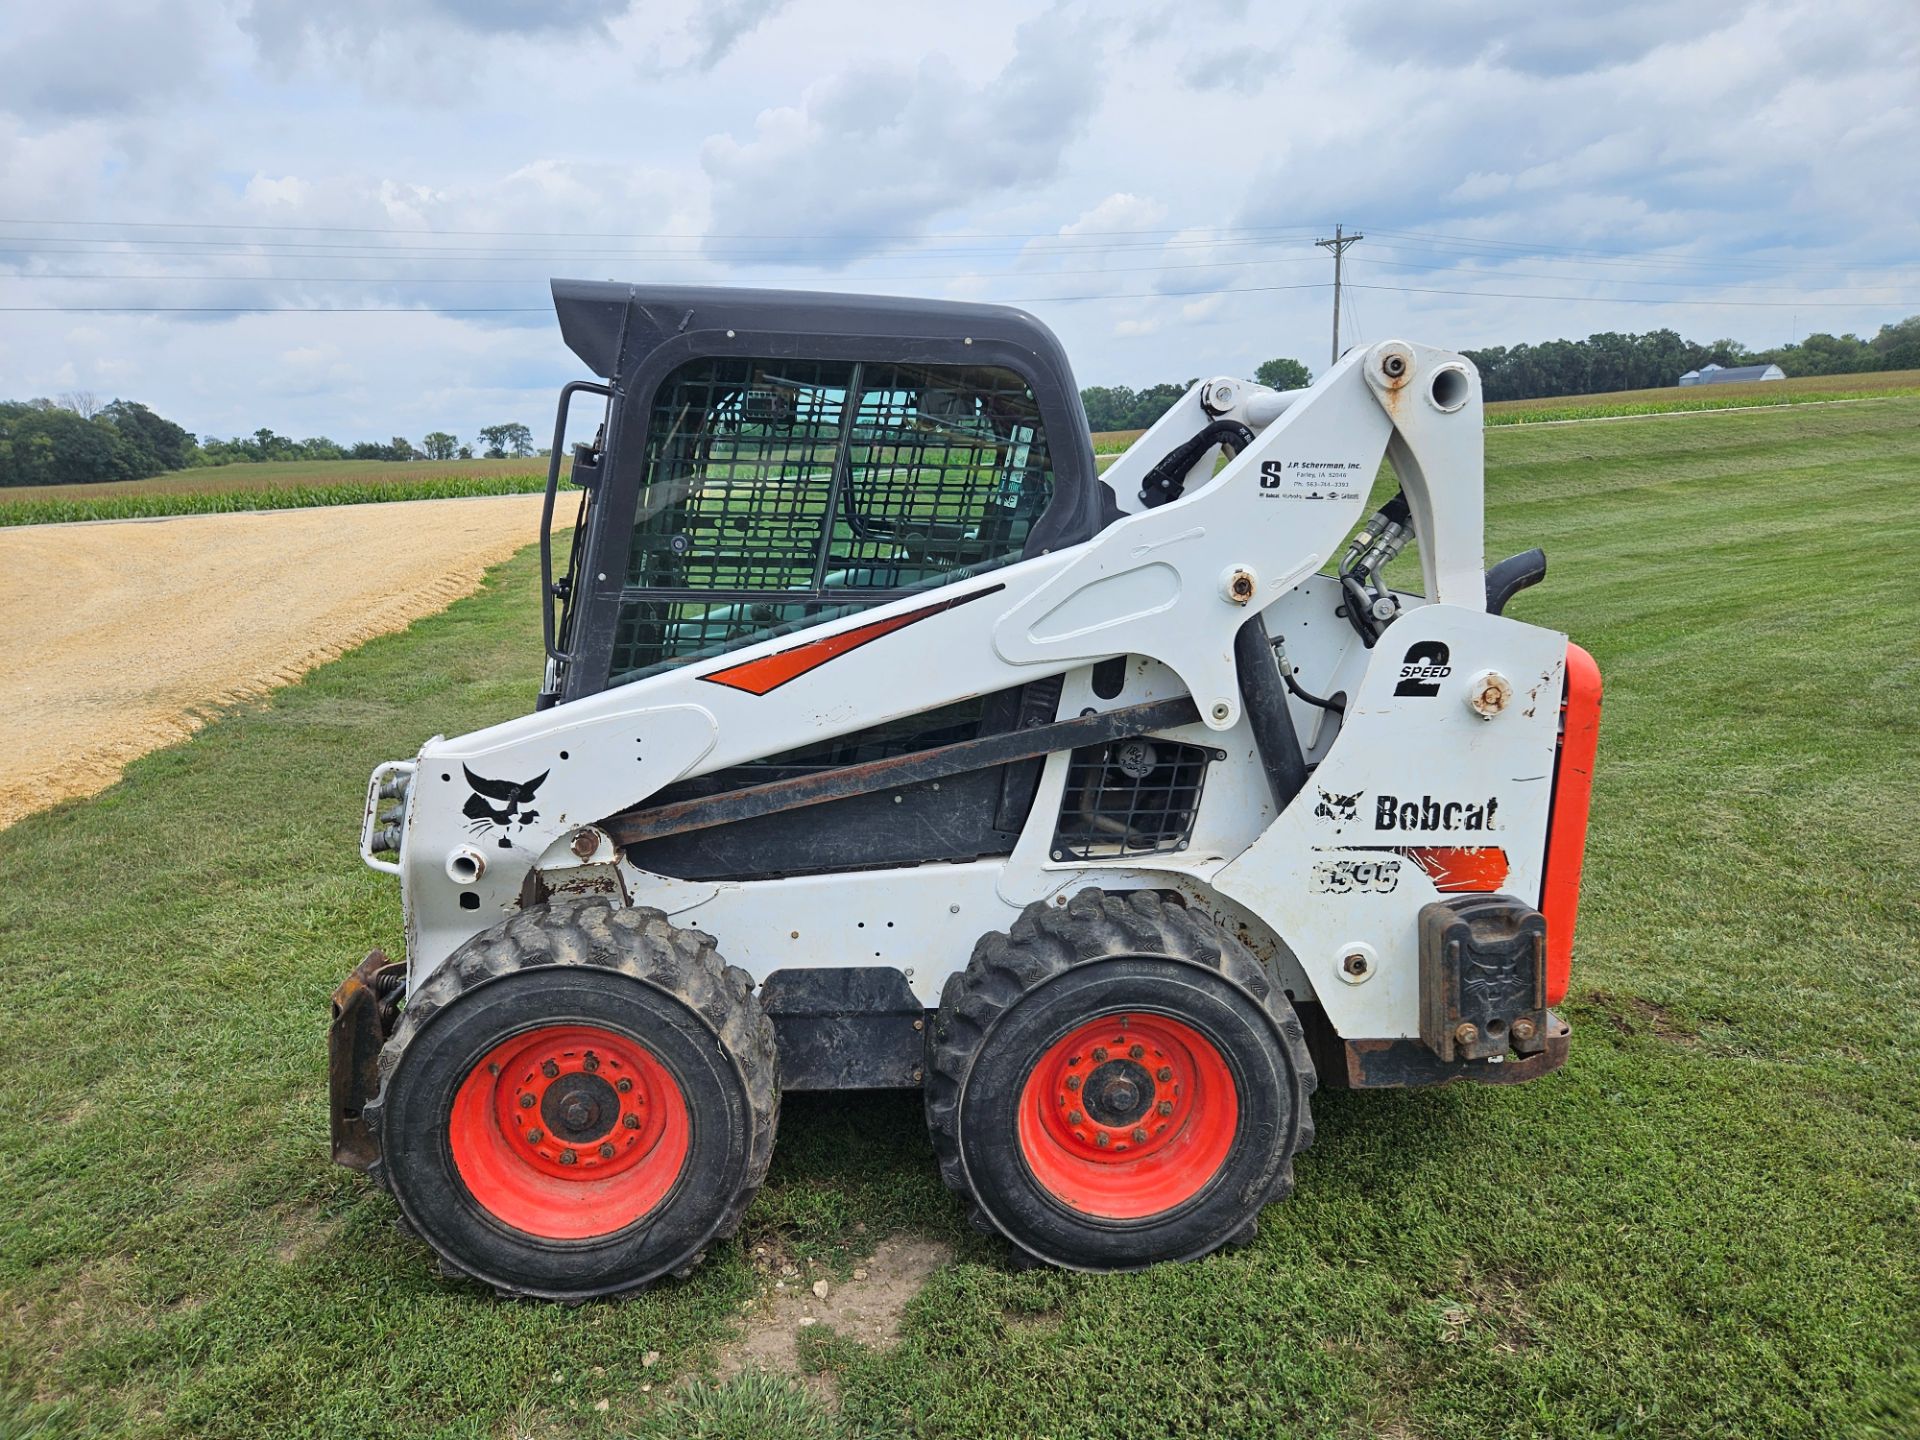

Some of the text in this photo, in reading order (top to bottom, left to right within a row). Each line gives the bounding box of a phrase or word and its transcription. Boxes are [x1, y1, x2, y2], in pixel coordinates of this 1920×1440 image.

[1301, 461, 1347, 470] Scherrman,
[1348, 462, 1362, 470] Inc.
[1393, 640, 1450, 697] 2
[1399, 665, 1452, 678] SPEED
[1374, 795, 1500, 831] Bobcat
